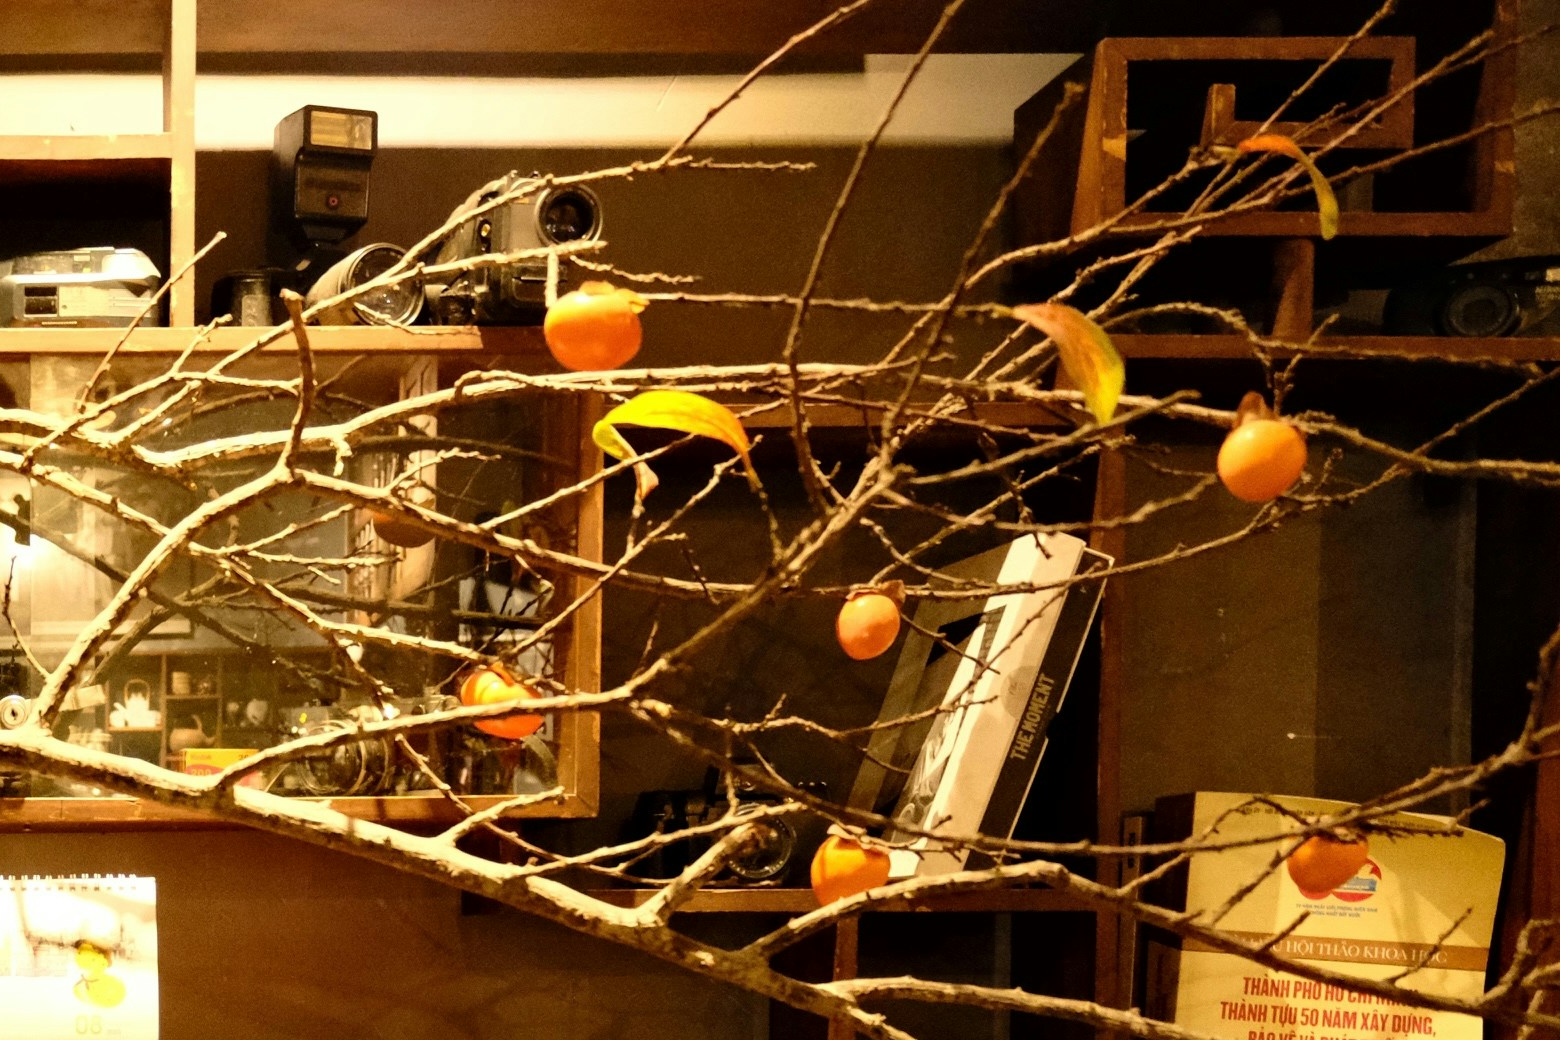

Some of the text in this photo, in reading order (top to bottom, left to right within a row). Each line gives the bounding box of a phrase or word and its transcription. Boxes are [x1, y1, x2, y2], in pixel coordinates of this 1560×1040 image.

[1009, 672, 1056, 760] THE MOMENT
[1286, 939, 1314, 956] HỘI
[1364, 945, 1410, 962] KHOA
[1243, 973, 1291, 998] THÀNH
[75, 1014, 103, 1035] 08
[1220, 998, 1267, 1023] THÀNH
[1300, 1008, 1319, 1027] 50
[1322, 1007, 1357, 1030] NĂM
[1360, 1009, 1389, 1032] XÂY
